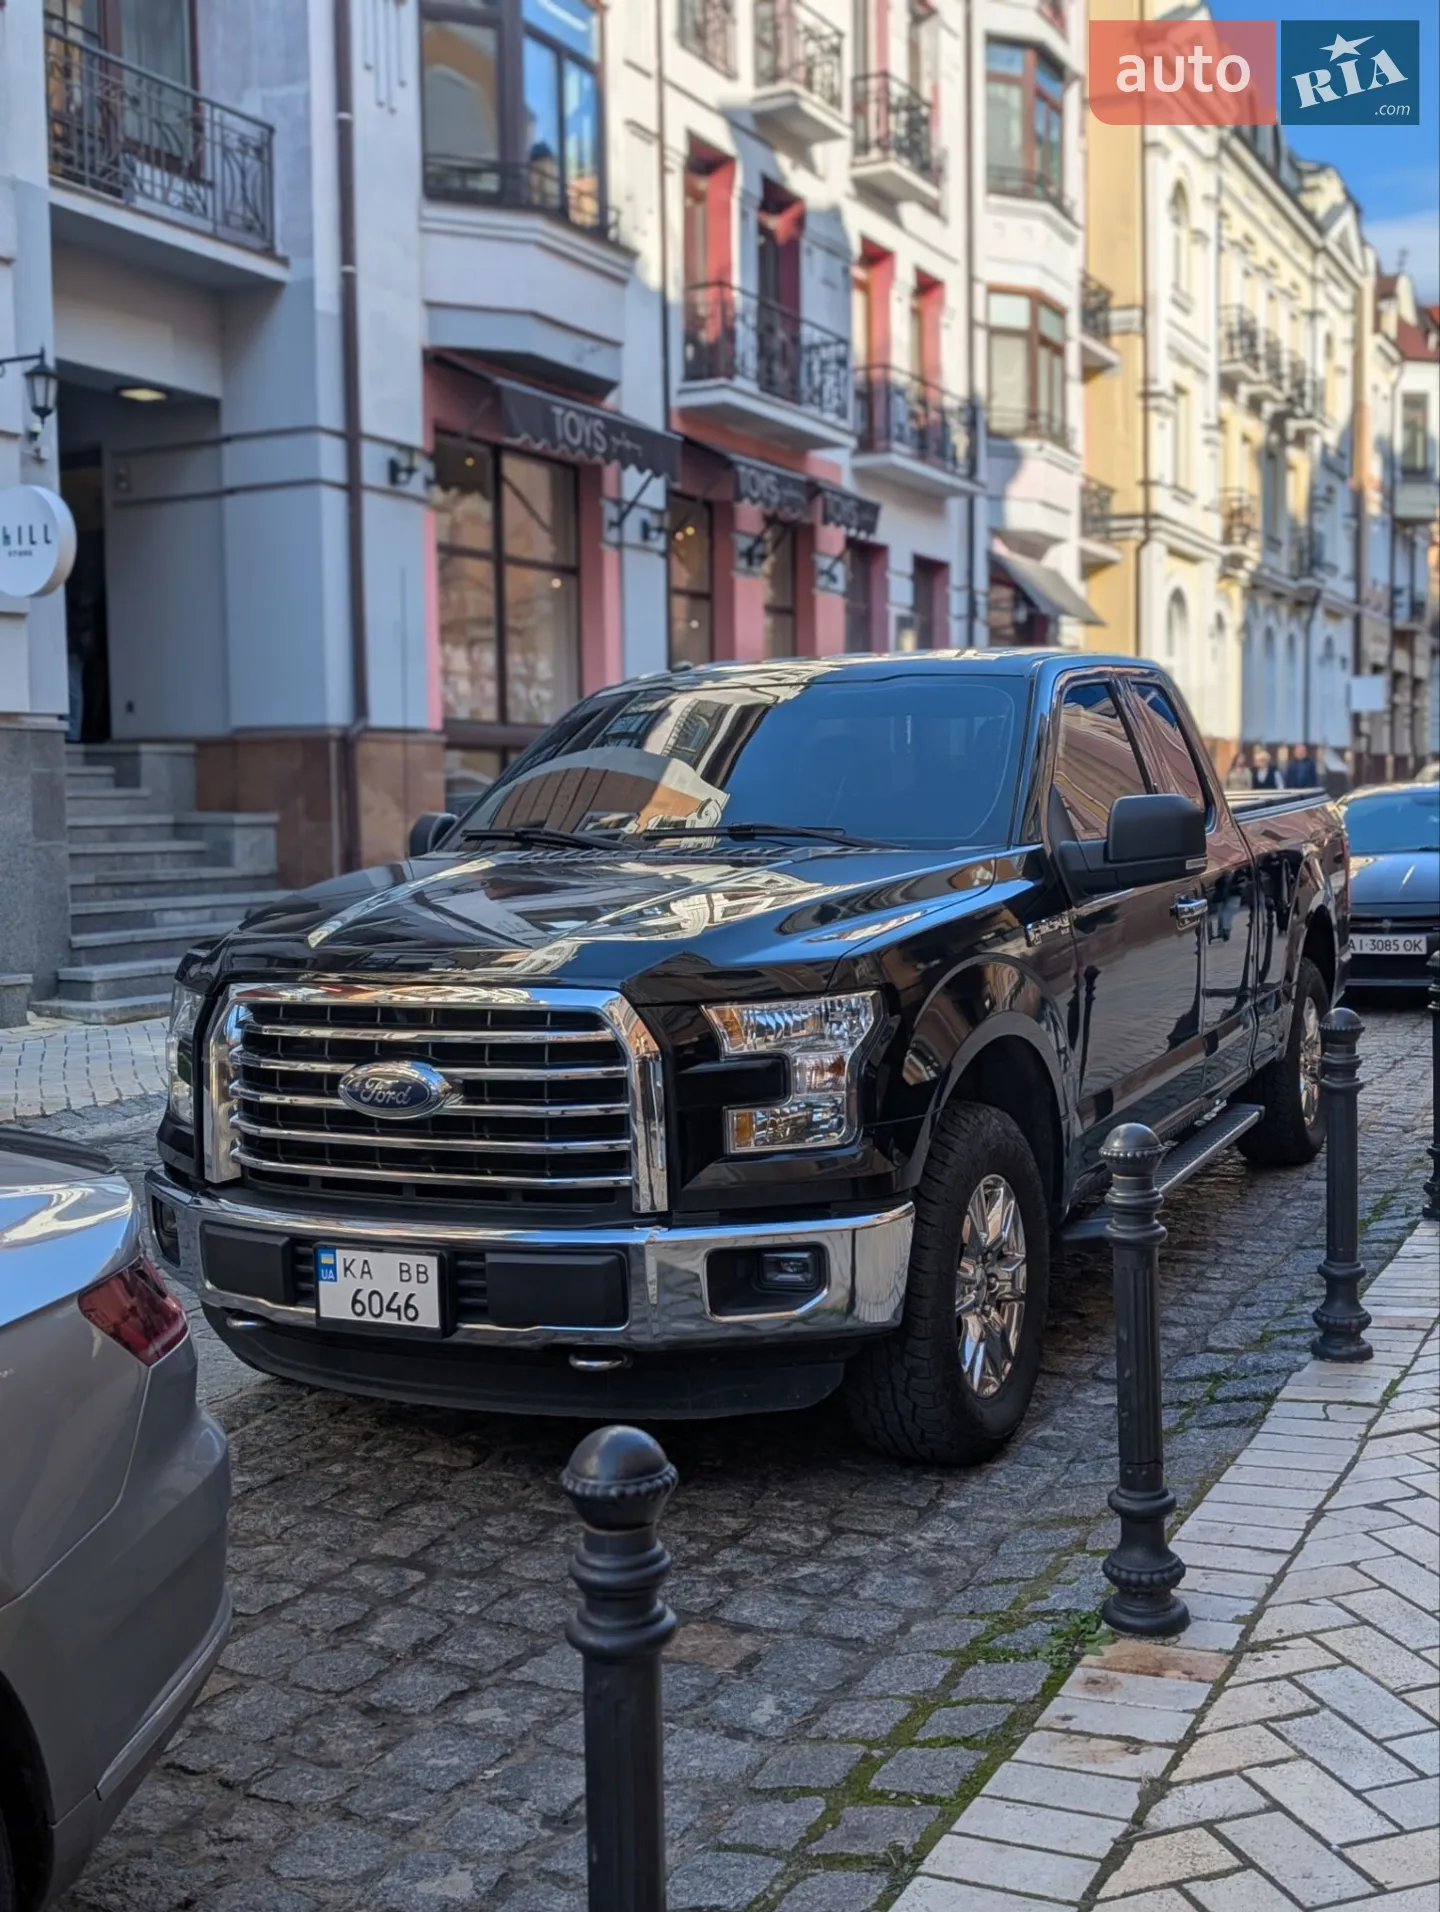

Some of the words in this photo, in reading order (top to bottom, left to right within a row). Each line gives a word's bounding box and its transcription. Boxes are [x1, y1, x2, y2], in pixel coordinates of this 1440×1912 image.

[550, 405, 608, 454] TOYS
[1369, 939, 1399, 951] 3085
[1403, 939, 1423, 952] OK
[360, 1077, 412, 1105] Ford
[321, 1268, 335, 1280] UA
[343, 1257, 373, 1280] KA
[399, 1262, 429, 1284] BB
[351, 1288, 419, 1322] 6046
